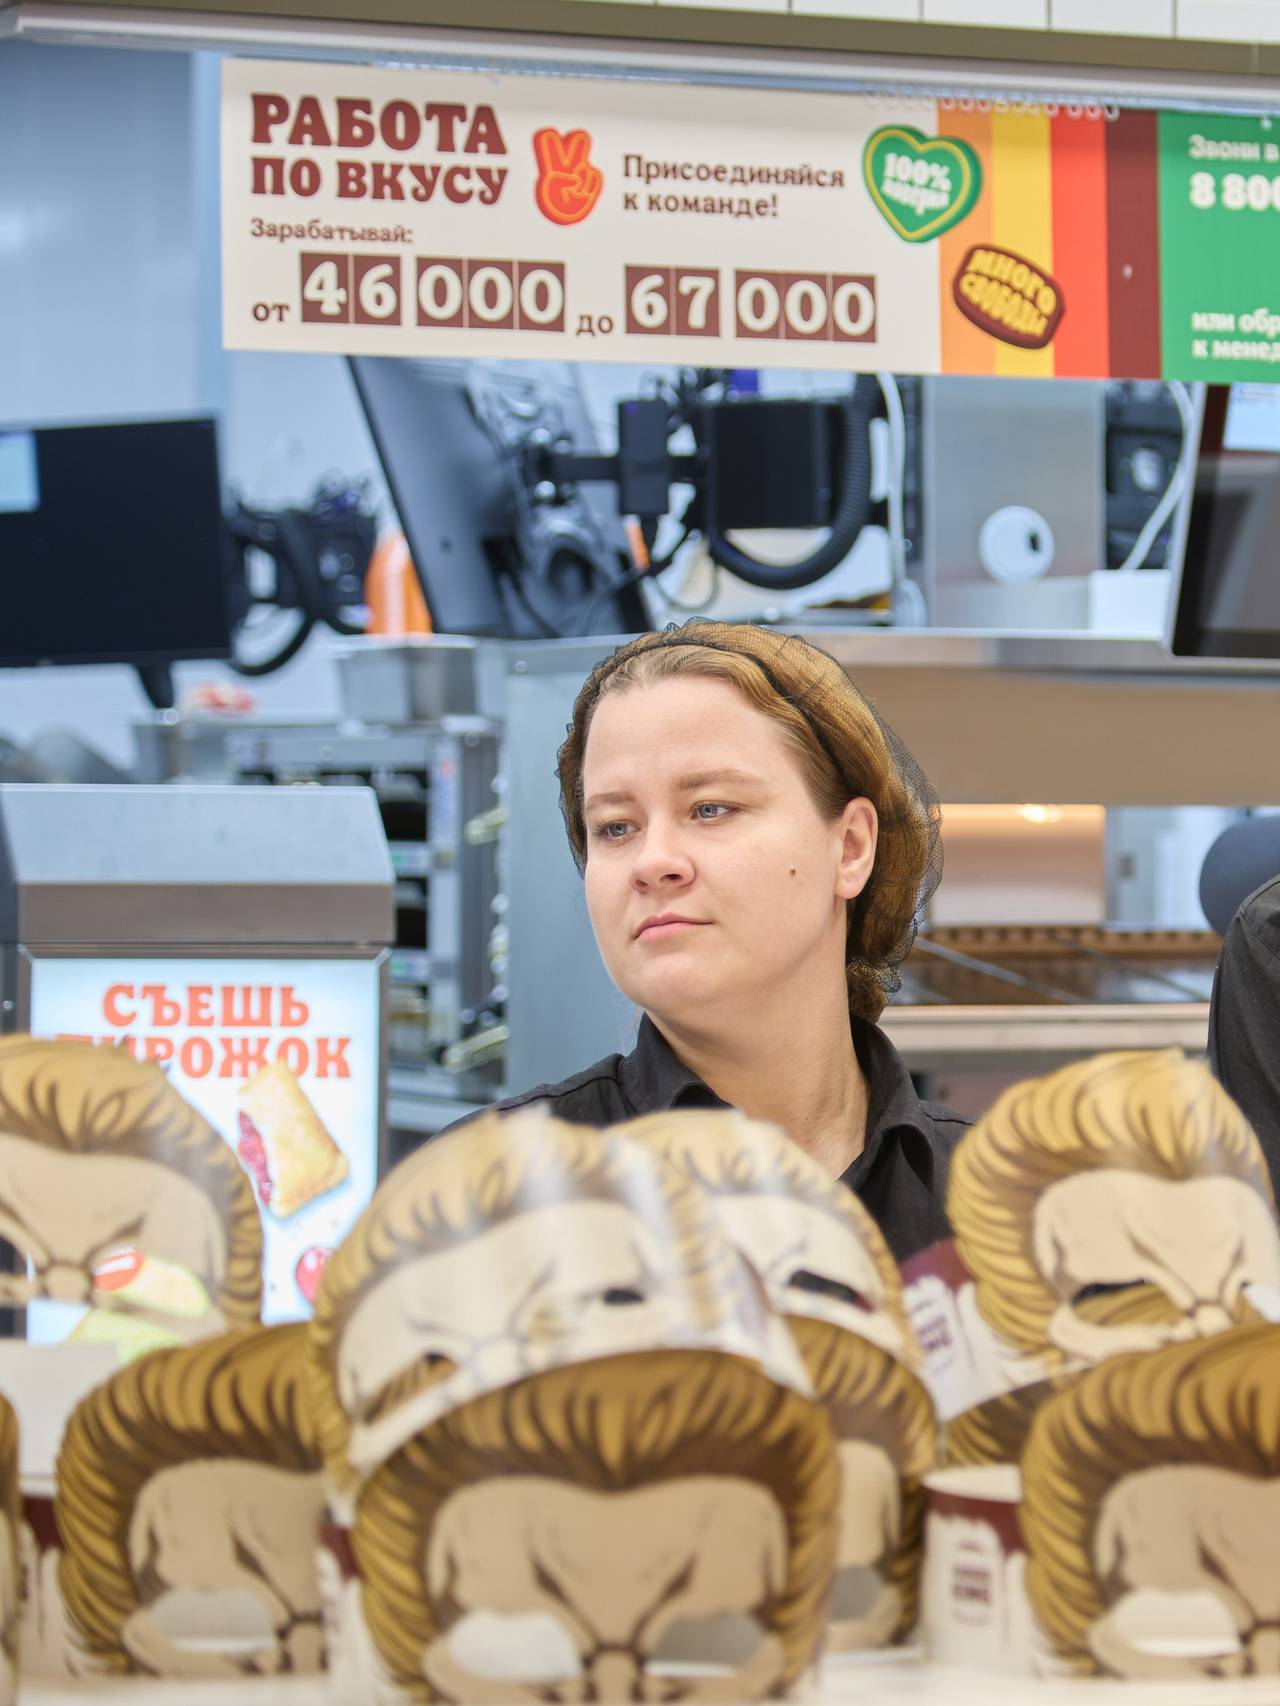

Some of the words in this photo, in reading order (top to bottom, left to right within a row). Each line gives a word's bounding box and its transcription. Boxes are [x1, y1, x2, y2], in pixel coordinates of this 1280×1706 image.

[250, 93, 508, 155] РАБОТА
[1189, 134, 1260, 161] Звони
[1264, 143, 1279, 163] в
[251, 157, 320, 197] ПО
[337, 162, 509, 206] ВКУСУ
[623, 153, 845, 189] Присоединяйся
[884, 153, 952, 191] 100%
[623, 193, 639, 212] к
[648, 194, 778, 219] команде!
[1190, 172, 1216, 210] 8
[250, 217, 412, 244] Зарабатывай:
[253, 300, 289, 324] от
[303, 260, 398, 319] 46
[417, 264, 563, 324] 000
[576, 313, 613, 338] до
[630, 273, 716, 329] 67
[737, 276, 875, 336] 000
[1191, 311, 1235, 332] или
[1192, 338, 1209, 359] к
[102, 984, 310, 1028] СЪЕШЬ
[56, 1033, 352, 1079] РОЖОК
